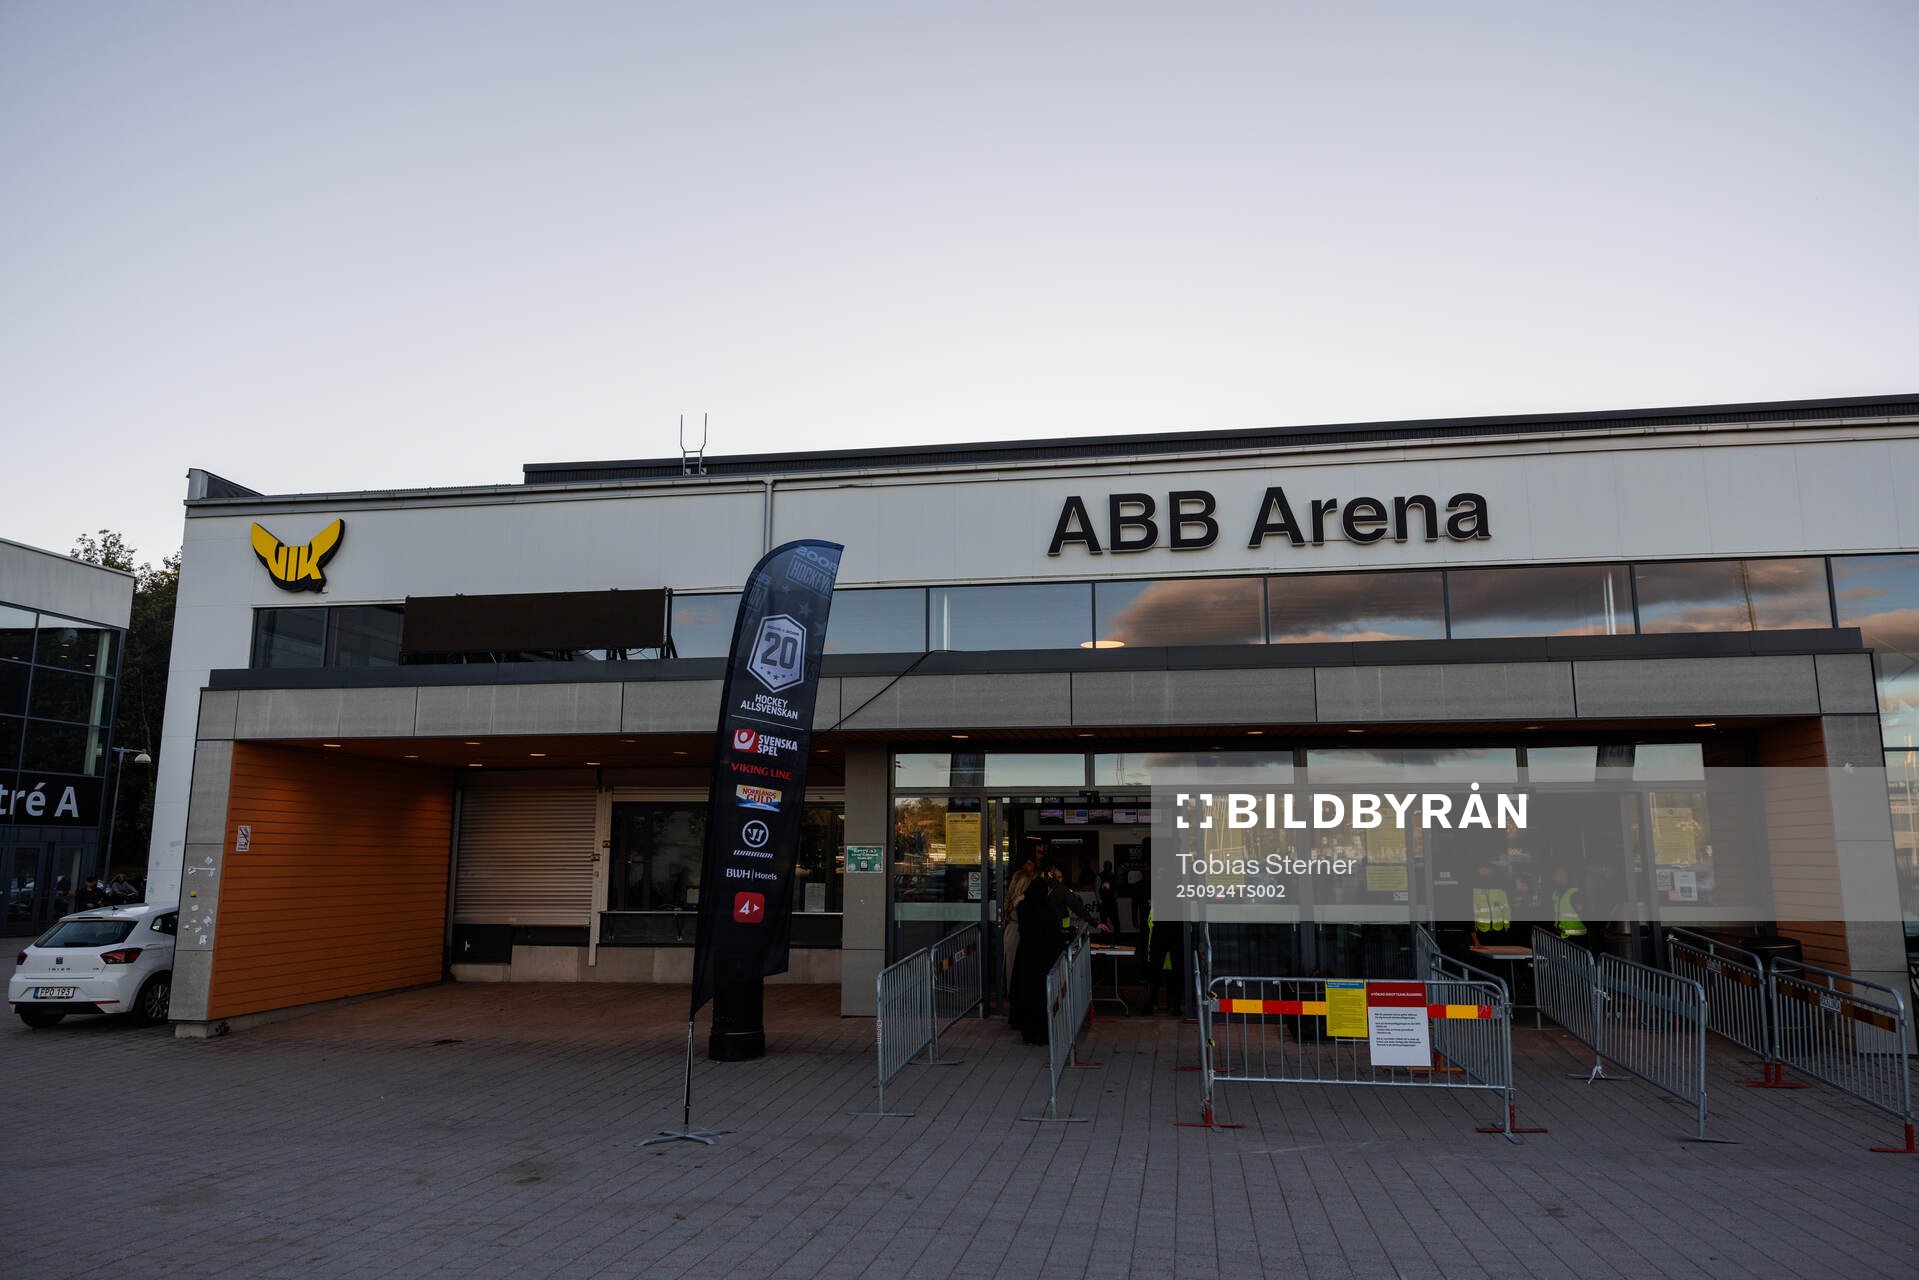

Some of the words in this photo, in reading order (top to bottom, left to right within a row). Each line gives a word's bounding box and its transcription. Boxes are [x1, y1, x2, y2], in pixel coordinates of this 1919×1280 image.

[1048, 489, 1219, 556] ABB
[1248, 486, 1492, 549] Arena
[760, 631, 798, 669] 20
[755, 693, 788, 708] HOCKEY
[741, 700, 798, 719] ALLSVENSKAN
[757, 743, 778, 756] SPEL
[758, 734, 798, 751] SVENSKA
[731, 762, 769, 776] VIKING
[770, 768, 793, 780] LINE
[742, 787, 777, 799] NORRLANDS
[746, 793, 773, 803] GULD
[54, 786, 79, 818] A
[726, 868, 751, 879] BWH
[754, 871, 778, 880] Hotels
[739, 899, 750, 915] 4
